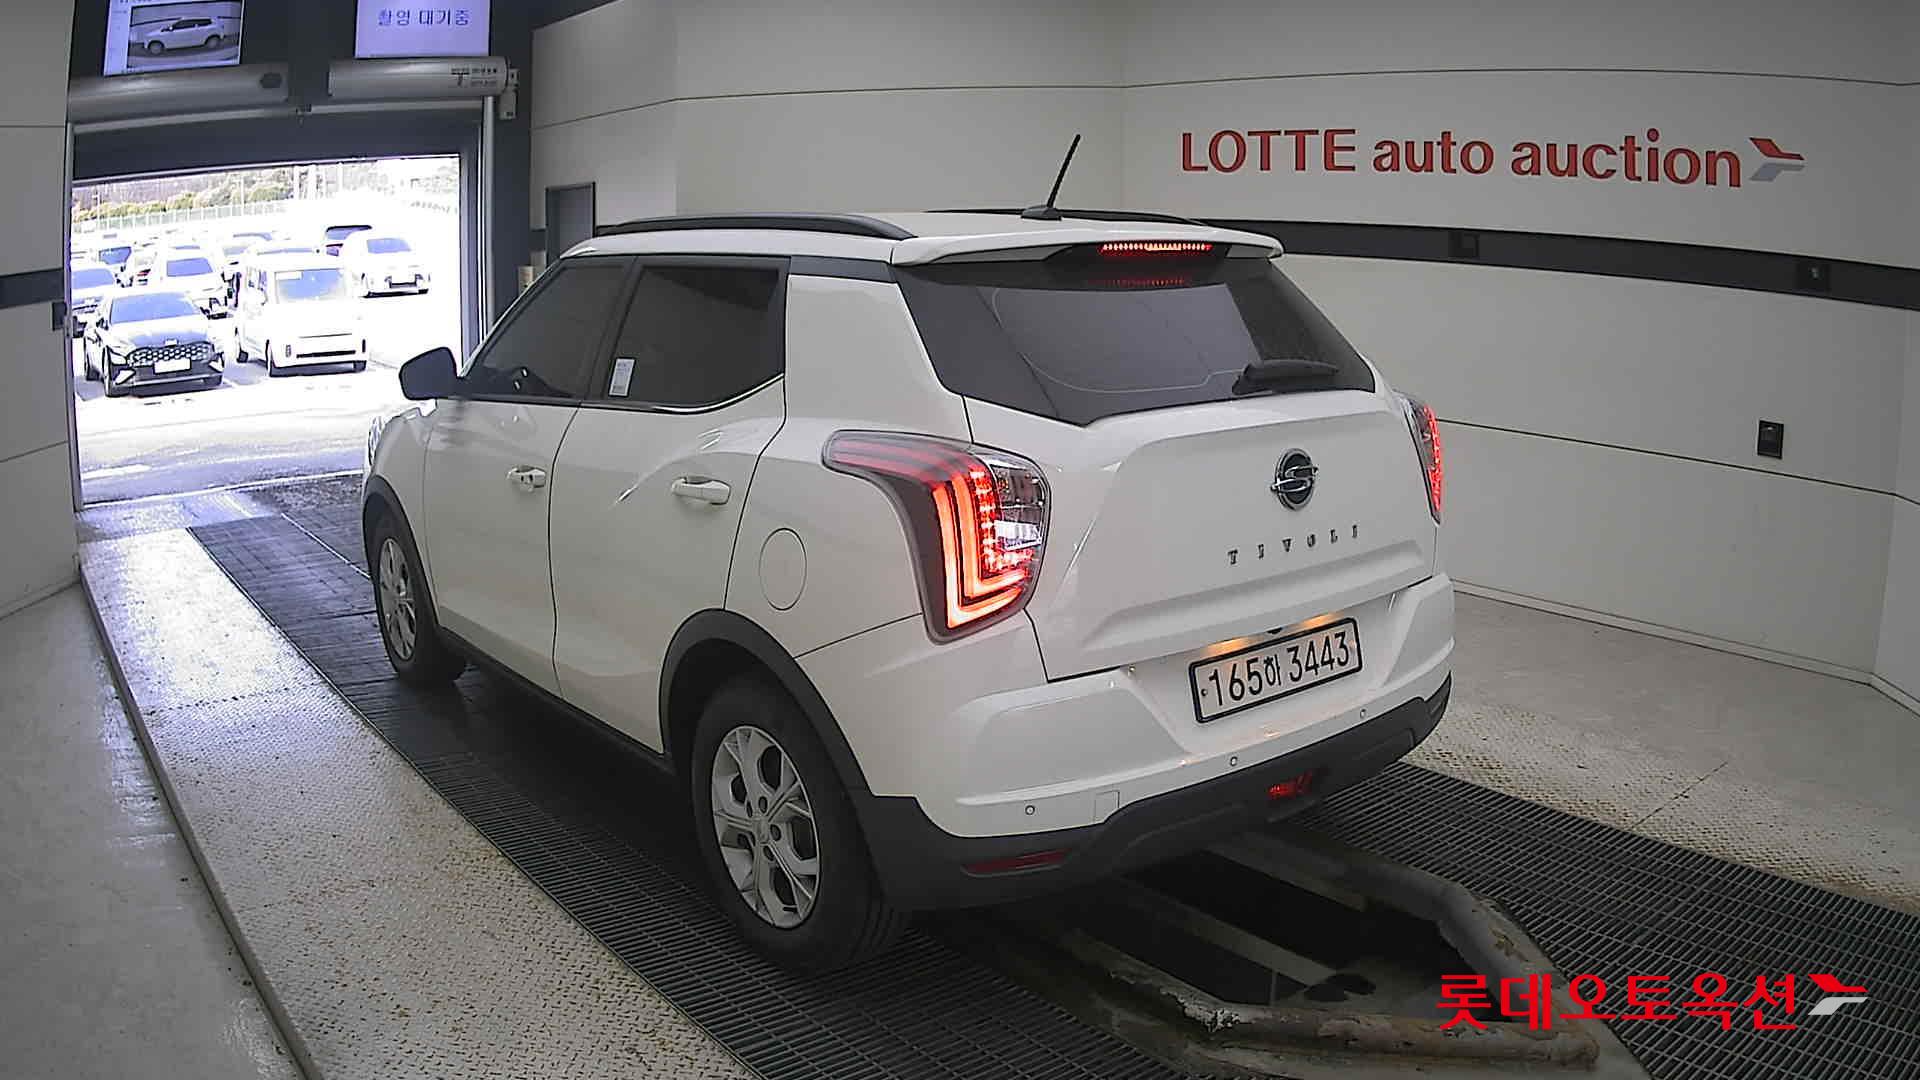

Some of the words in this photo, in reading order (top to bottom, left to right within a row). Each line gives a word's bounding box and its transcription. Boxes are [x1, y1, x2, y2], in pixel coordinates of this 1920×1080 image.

[419, 8, 470, 26] 대기중
[1181, 128, 1357, 172] LOTTE
[1372, 131, 1495, 175] auto
[1511, 127, 1742, 188] auction
[1227, 523, 1361, 566] TIVOLI
[1208, 653, 1282, 707] 165하
[1286, 630, 1350, 683] 3443
